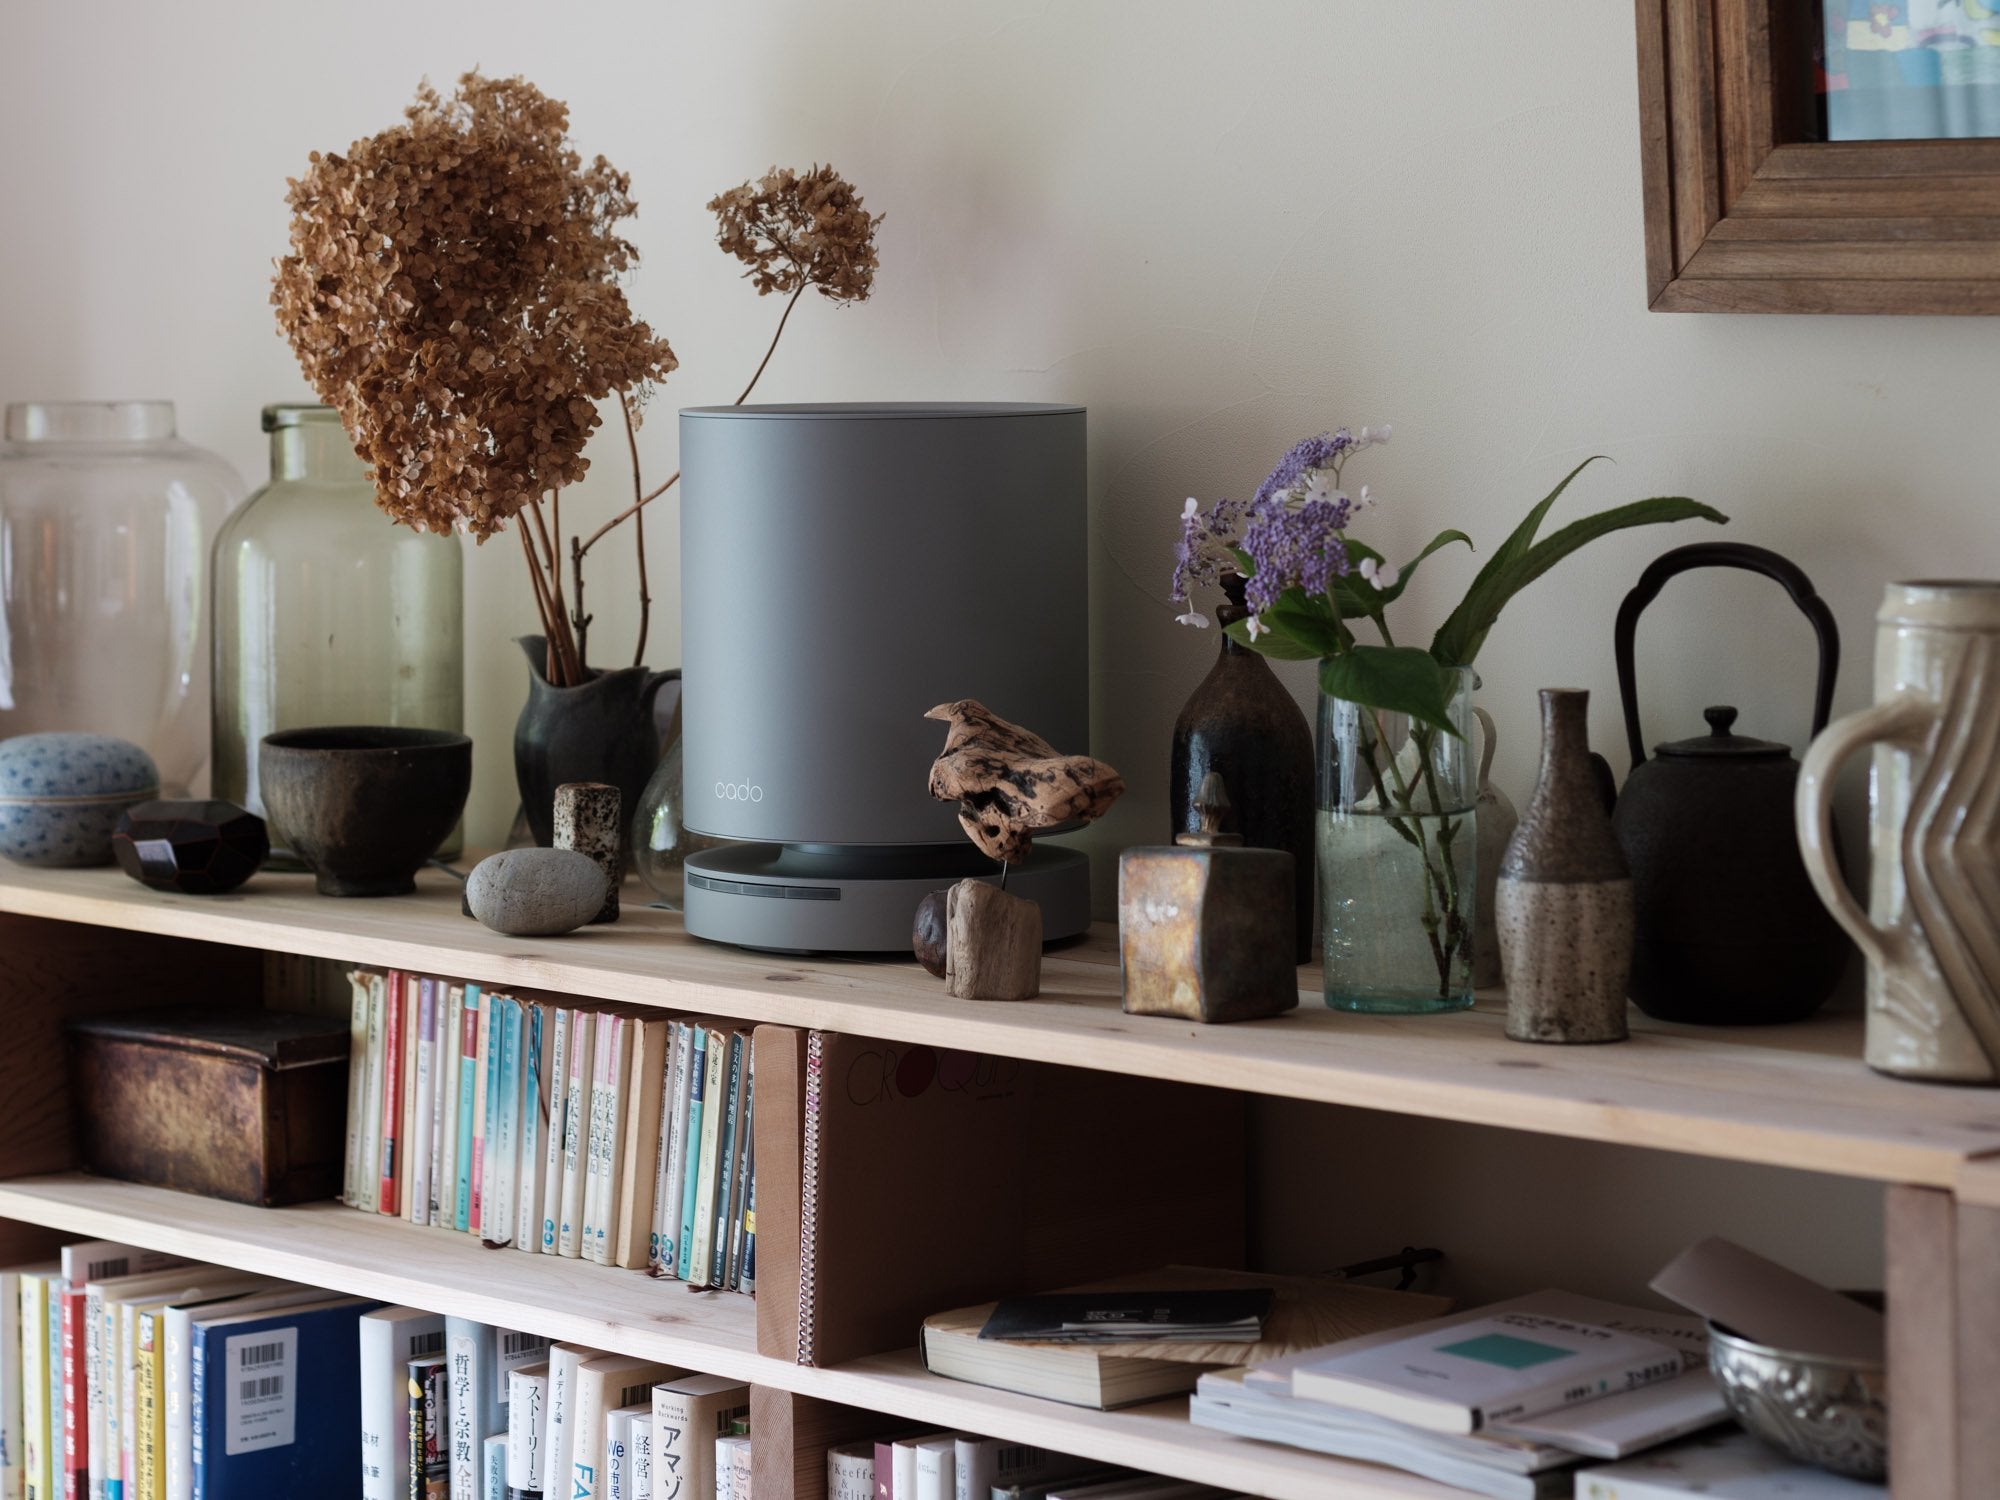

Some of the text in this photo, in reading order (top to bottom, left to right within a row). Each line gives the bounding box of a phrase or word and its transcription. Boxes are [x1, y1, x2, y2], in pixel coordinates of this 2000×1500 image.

[715, 777, 763, 802] cado
[553, 1368, 563, 1424] メディア論
[657, 1410, 688, 1422] Backwards
[661, 1403, 684, 1414] Working
[828, 1461, 876, 1480] 'Keeffe
[841, 1479, 848, 1489] &
